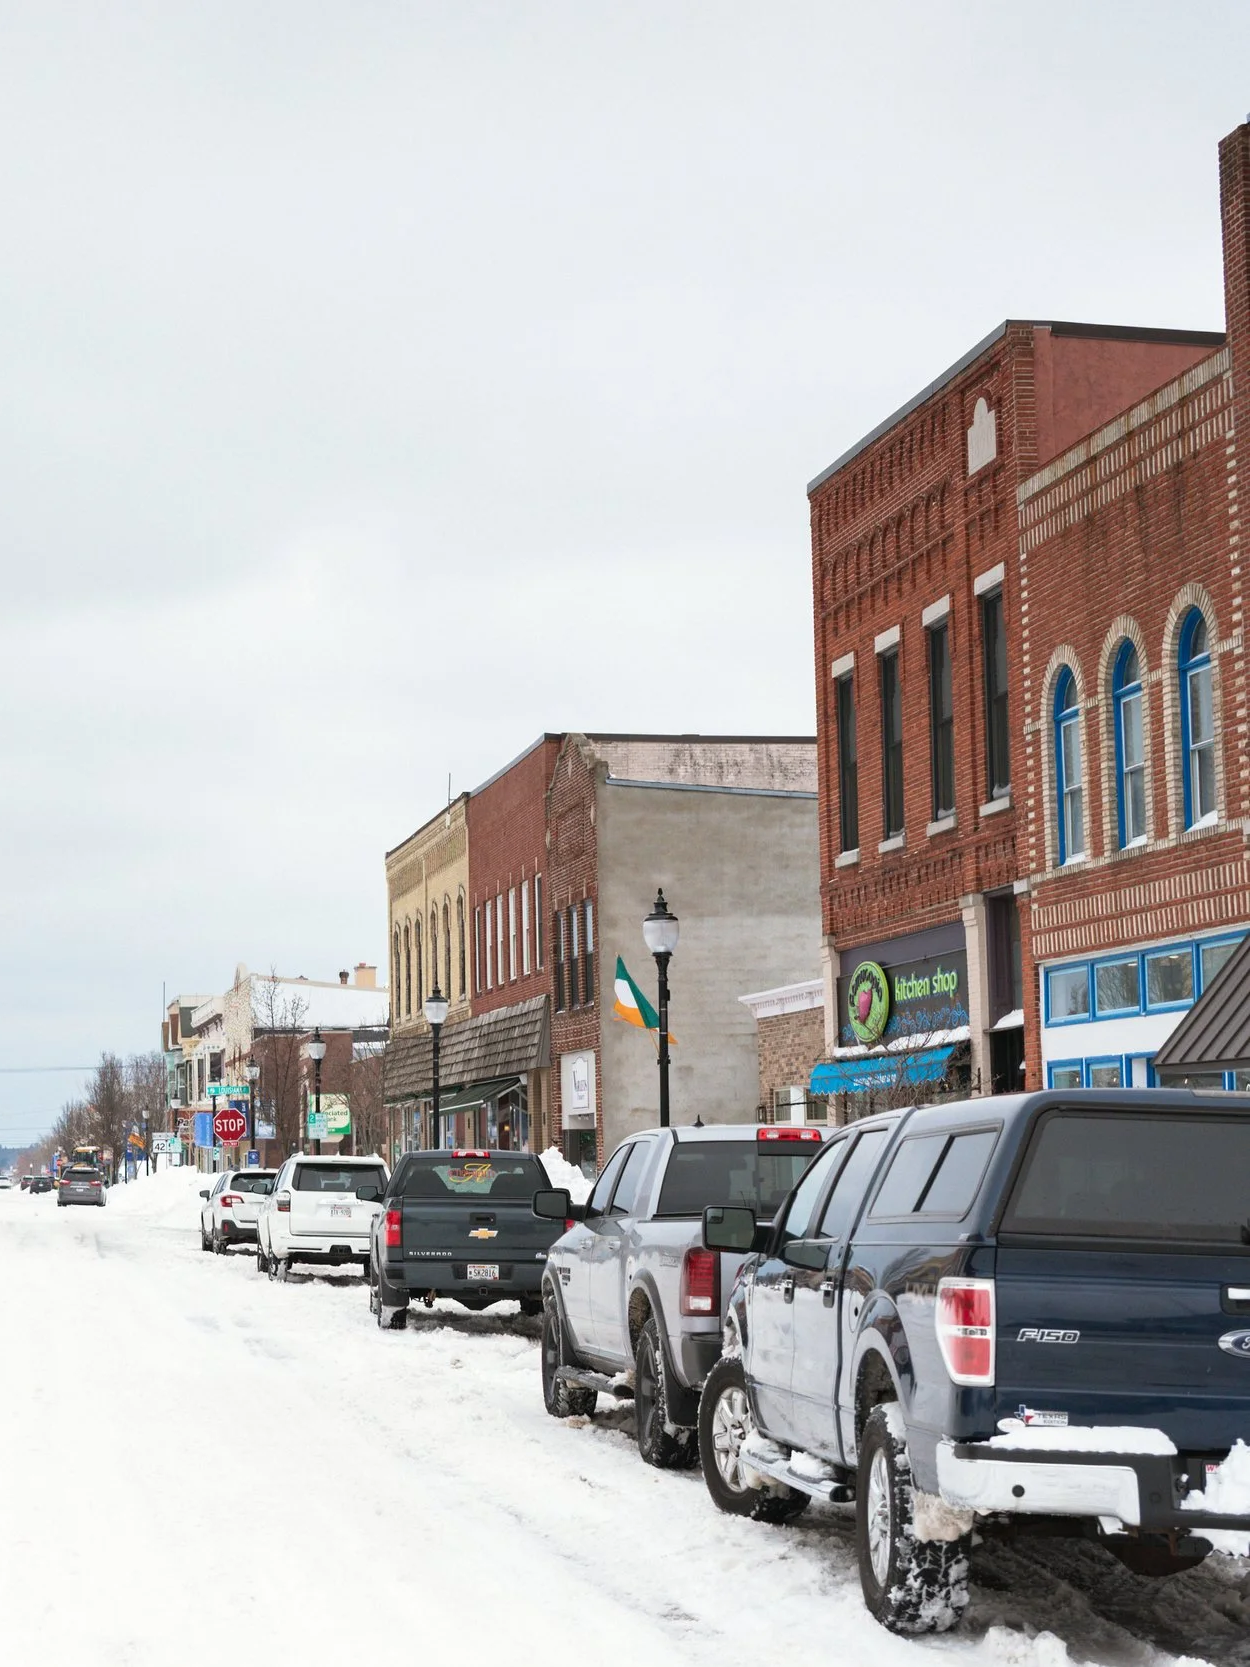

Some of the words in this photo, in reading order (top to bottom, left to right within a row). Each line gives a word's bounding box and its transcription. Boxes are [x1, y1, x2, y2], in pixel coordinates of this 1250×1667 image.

[894, 972, 930, 1001] kitchen
[932, 966, 958, 998] shop
[219, 1086, 242, 1095] LOUISIANA
[309, 1114, 315, 1123] 2
[215, 1118, 244, 1132] STOP
[154, 1143, 166, 1151] 42
[1017, 1328, 1081, 1344] F-150
